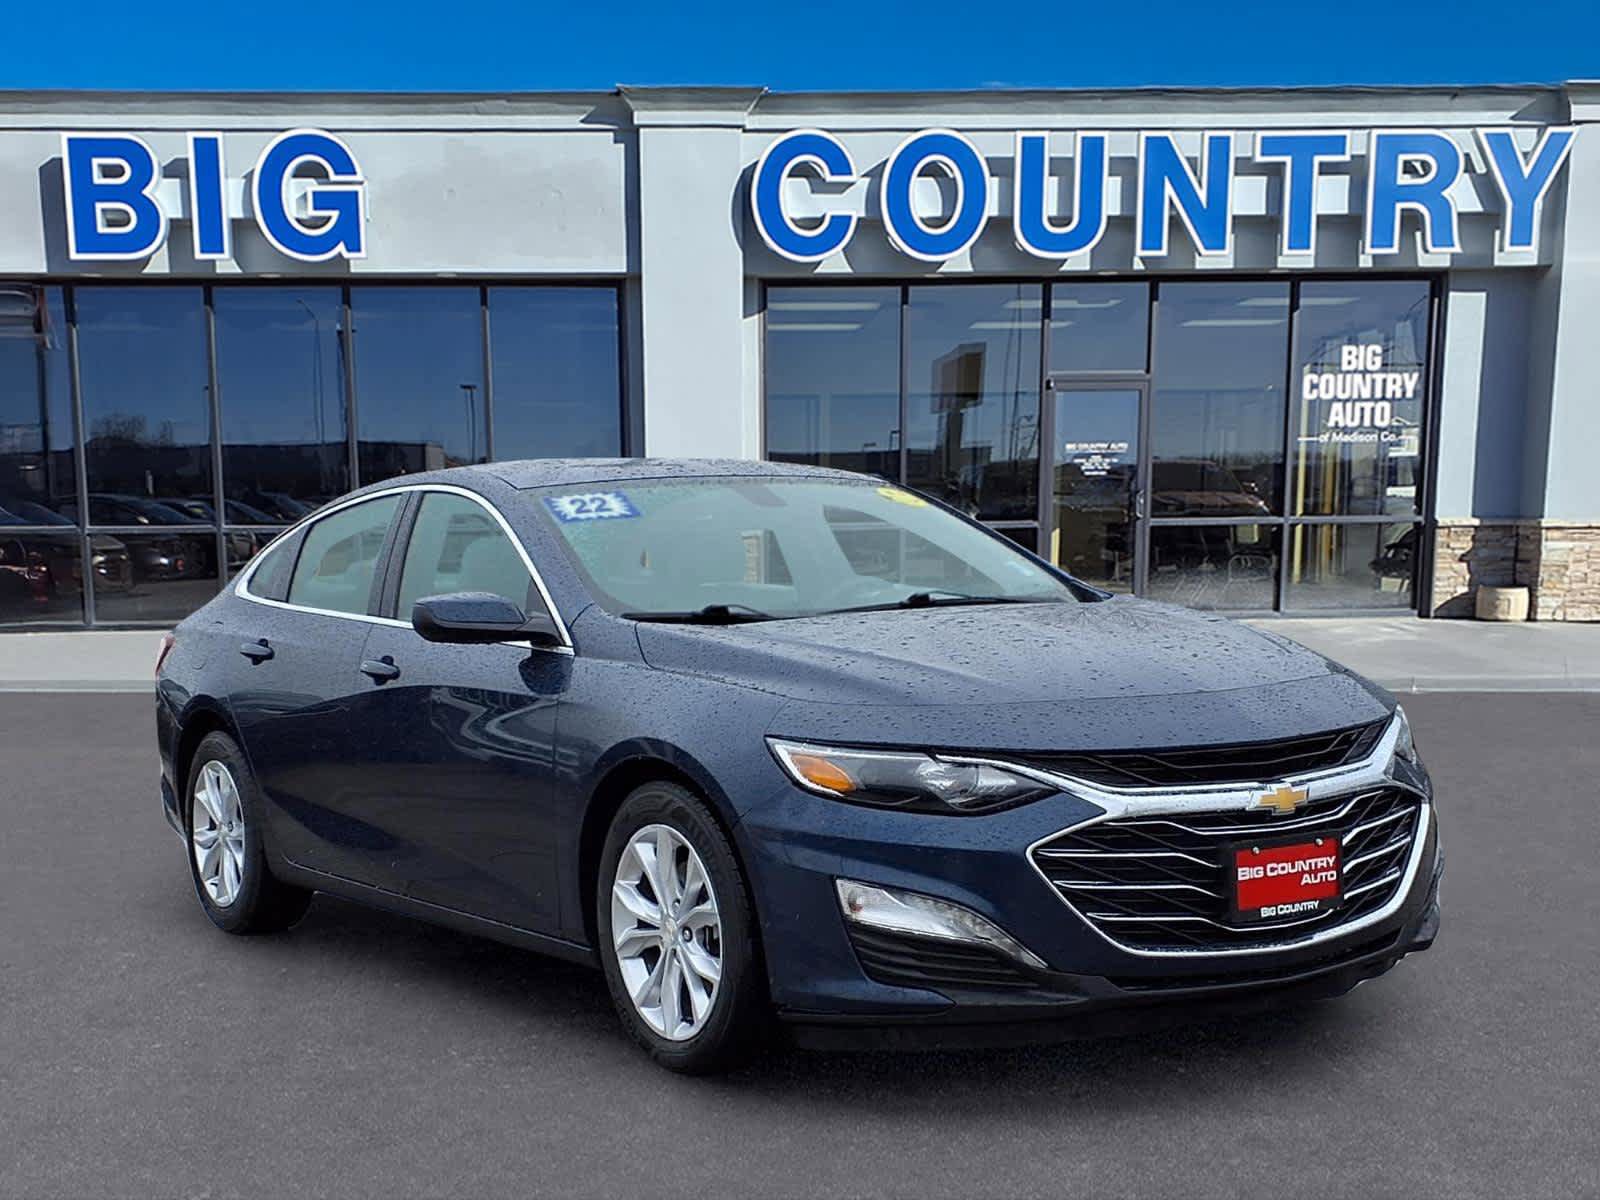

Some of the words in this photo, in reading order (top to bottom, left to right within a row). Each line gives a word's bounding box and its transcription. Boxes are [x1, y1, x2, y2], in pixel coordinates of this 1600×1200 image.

[61, 128, 367, 261] BIG
[751, 127, 1577, 263] COUNTRY
[1341, 344, 1383, 371] BIG
[1303, 372, 1419, 400] COUNTRY
[1328, 401, 1392, 428] AUTO
[1319, 432, 1329, 443] of
[1331, 431, 1378, 442] Madison
[570, 496, 614, 514] 22
[1237, 866, 1264, 881] BIG
[1266, 855, 1336, 877] COUNTRY
[1300, 870, 1337, 886] AUTO
[1260, 905, 1276, 918] BIG
[1277, 900, 1320, 915] COUNTRY
